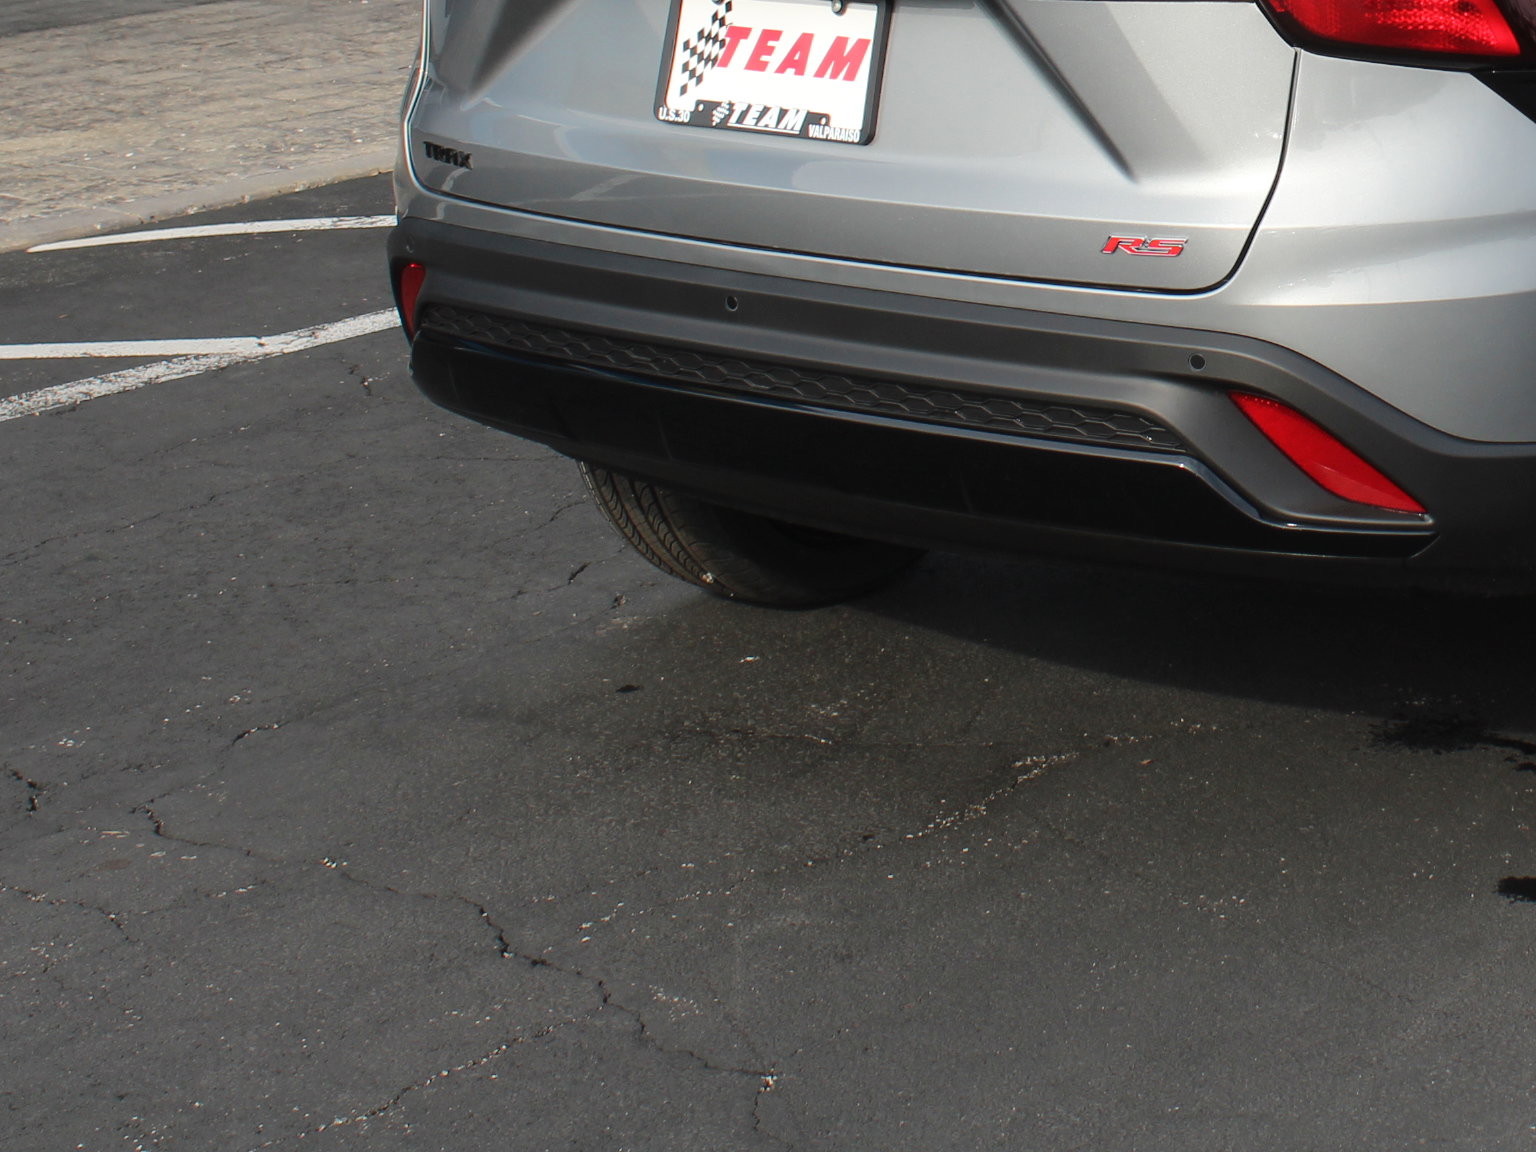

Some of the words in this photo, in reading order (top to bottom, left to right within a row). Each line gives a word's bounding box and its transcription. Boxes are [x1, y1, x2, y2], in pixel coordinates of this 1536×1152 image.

[717, 26, 871, 81] TEAM
[730, 102, 808, 131] TEAM
[808, 124, 861, 143] VALPARAISO
[1101, 235, 1188, 257] RS
